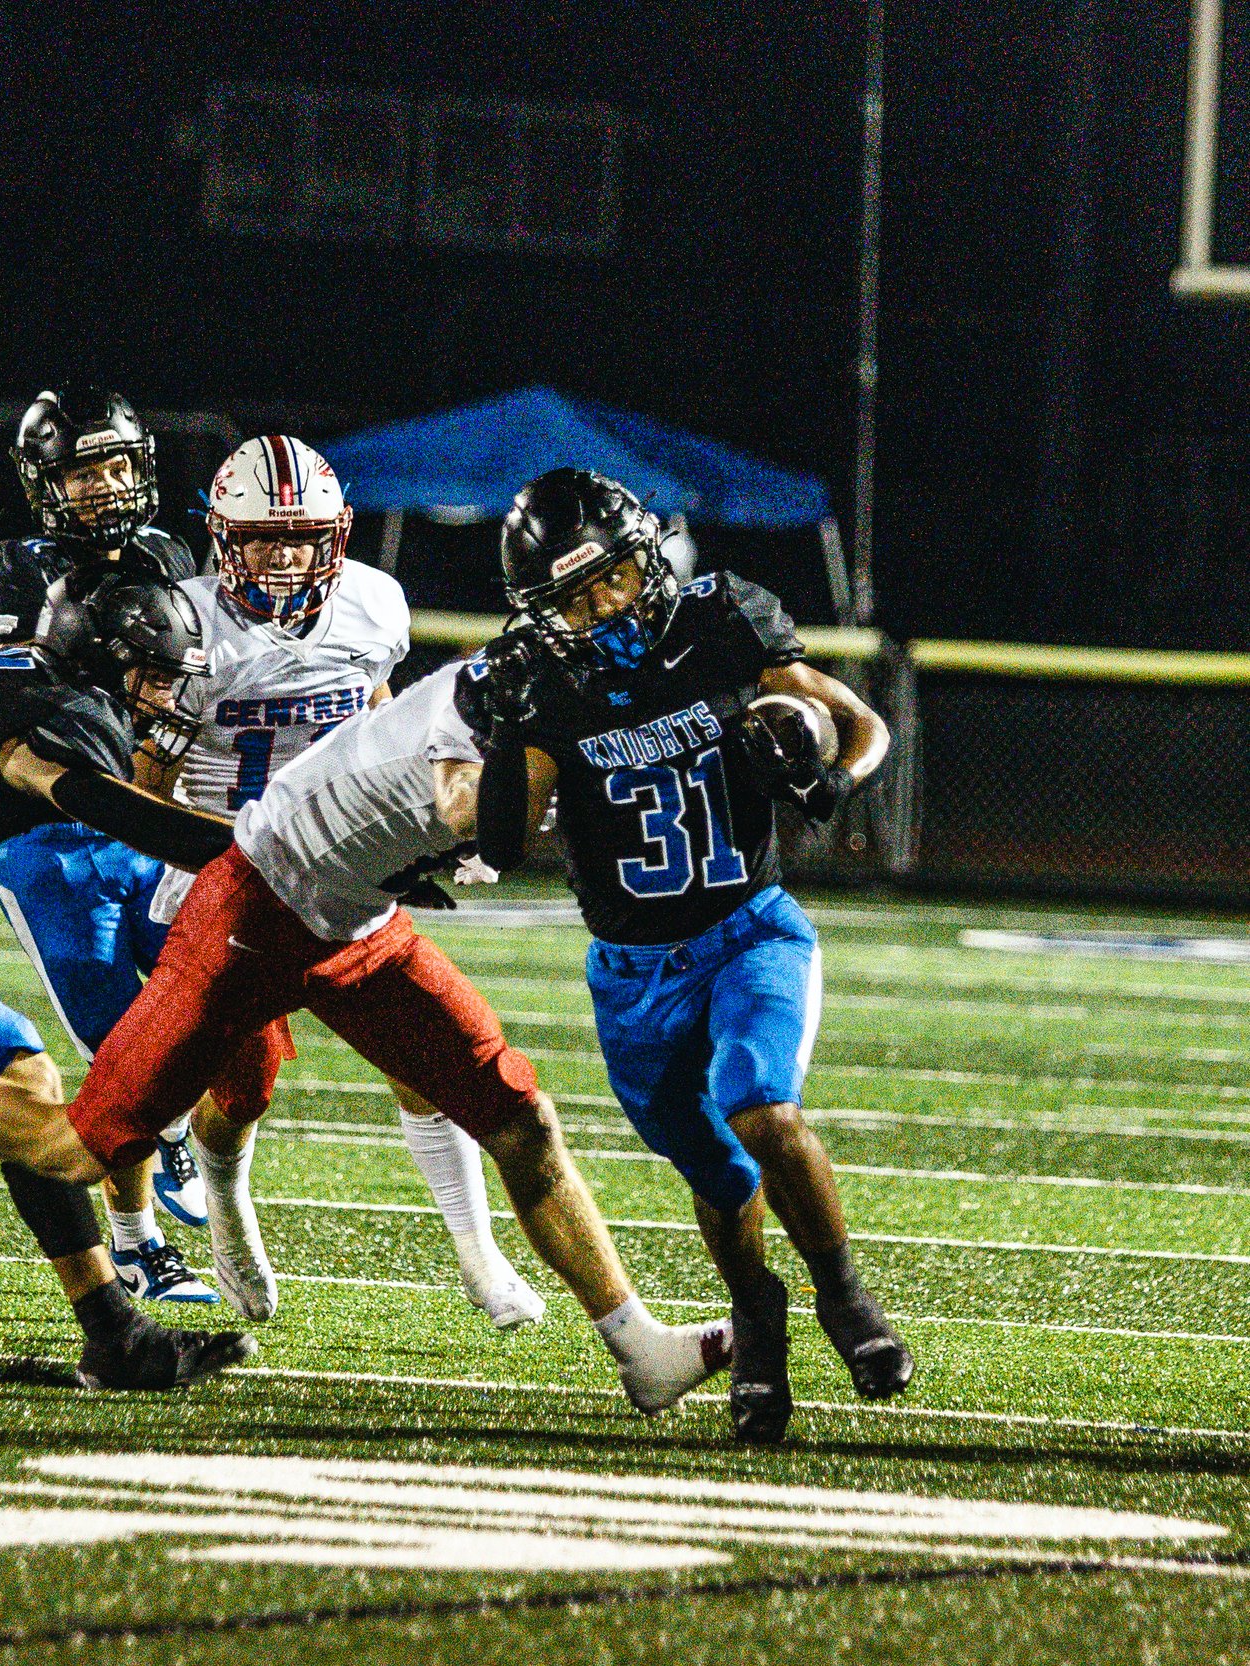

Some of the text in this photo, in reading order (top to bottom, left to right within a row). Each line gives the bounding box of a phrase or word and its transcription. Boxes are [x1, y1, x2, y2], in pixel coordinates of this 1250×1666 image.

[268, 508, 305, 517] Riddell
[556, 545, 595, 572] Riddell
[578, 700, 723, 769] KNIGHTS
[605, 746, 748, 898] 31
